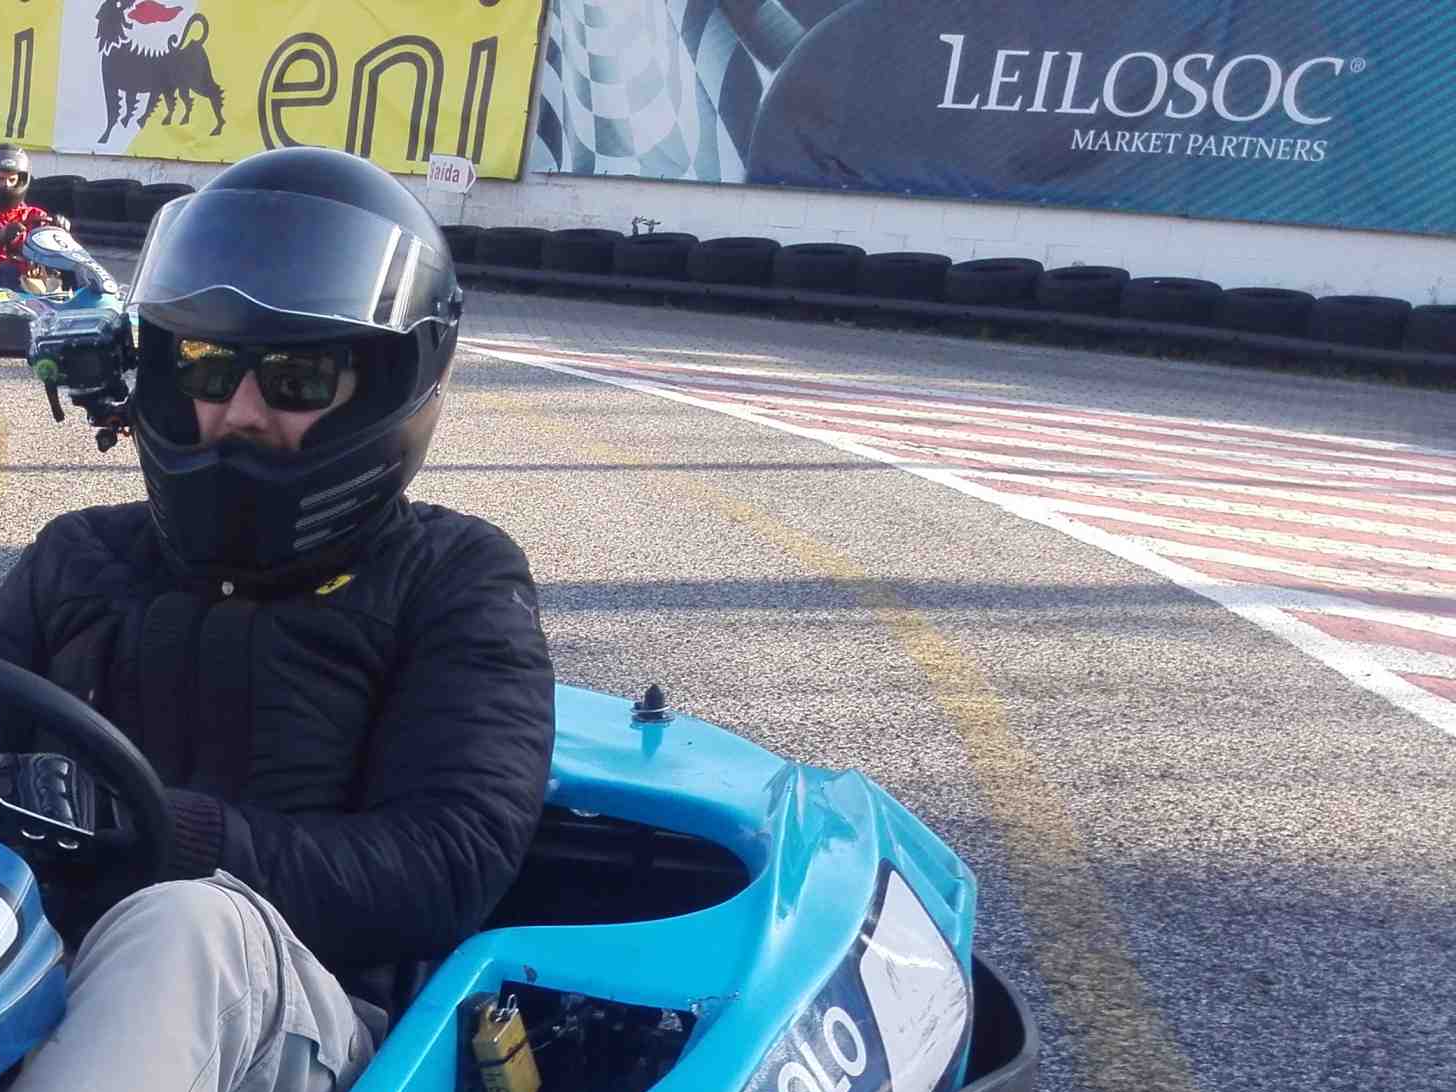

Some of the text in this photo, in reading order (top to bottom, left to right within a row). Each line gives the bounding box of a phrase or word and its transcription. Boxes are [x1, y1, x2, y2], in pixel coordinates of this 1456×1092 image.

[257, 0, 498, 165] eni
[1069, 129, 1327, 162] MARKET PARTNERS
